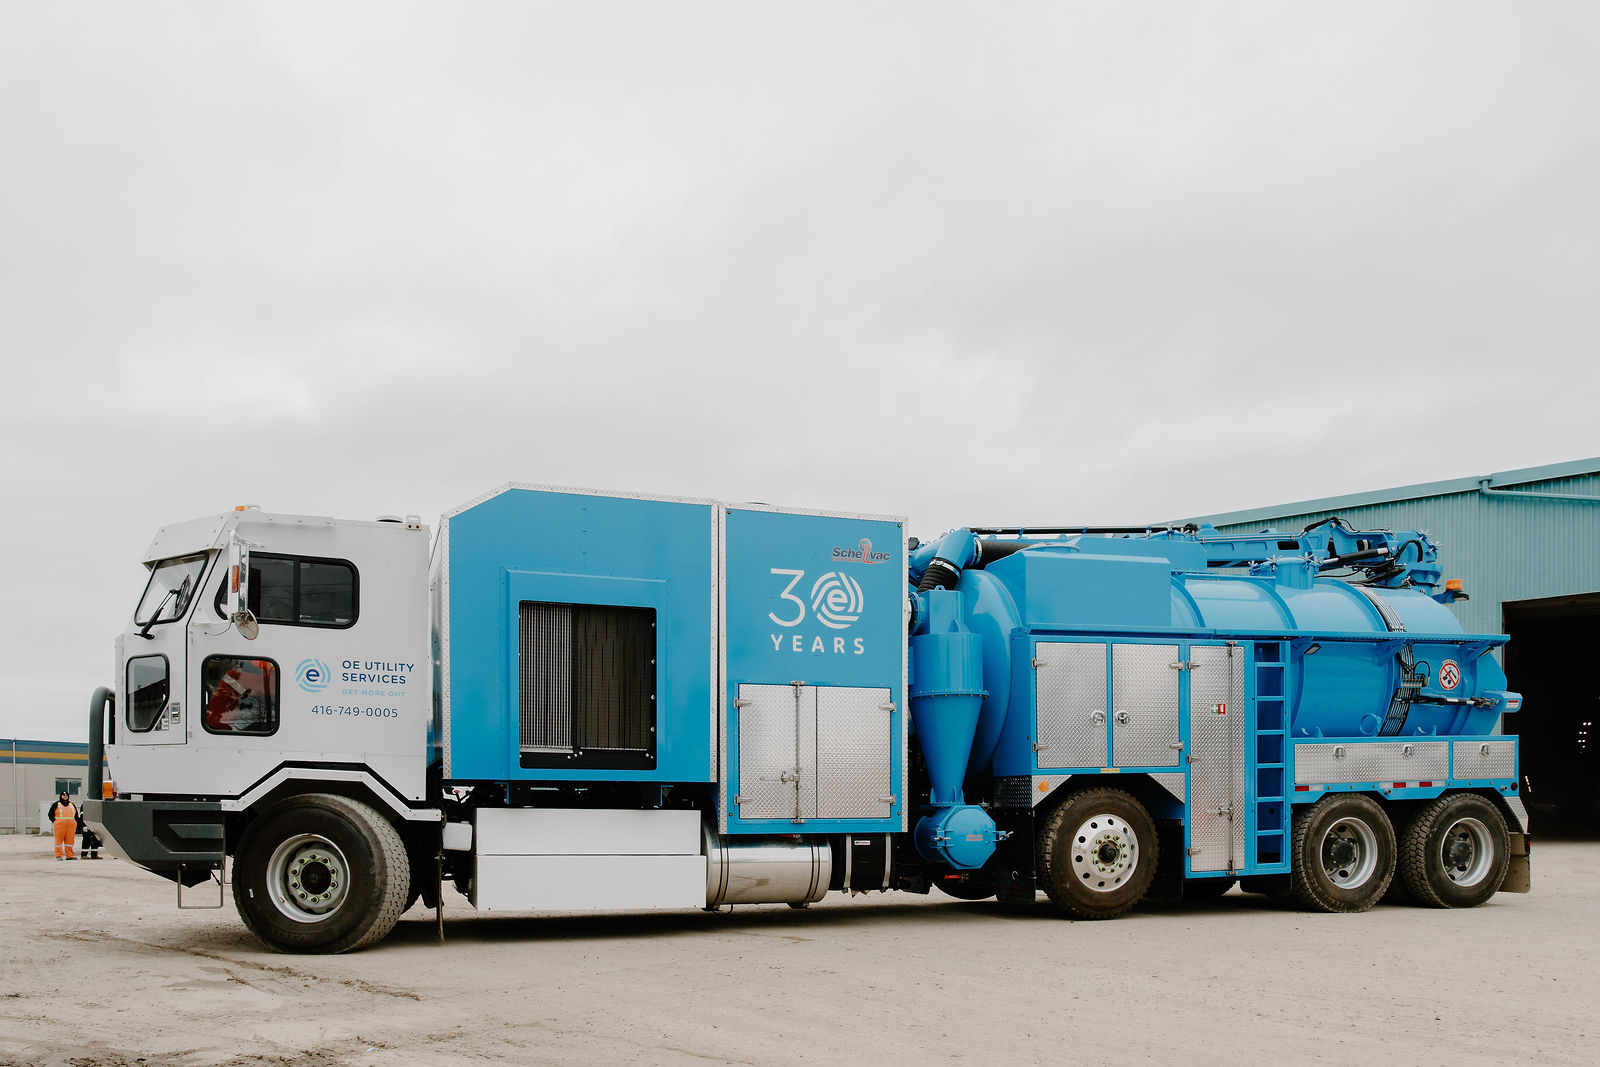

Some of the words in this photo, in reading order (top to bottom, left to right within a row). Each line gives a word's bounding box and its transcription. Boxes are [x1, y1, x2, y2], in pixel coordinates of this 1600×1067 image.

[770, 633, 865, 655] YEARS
[342, 660, 360, 670] OE
[365, 661, 414, 672] UTILITY
[342, 672, 406, 684] SERVICES
[342, 688, 358, 696] GET
[361, 689, 386, 697] MORE
[388, 690, 405, 698] OUT
[311, 705, 398, 718] 416-749-0005
